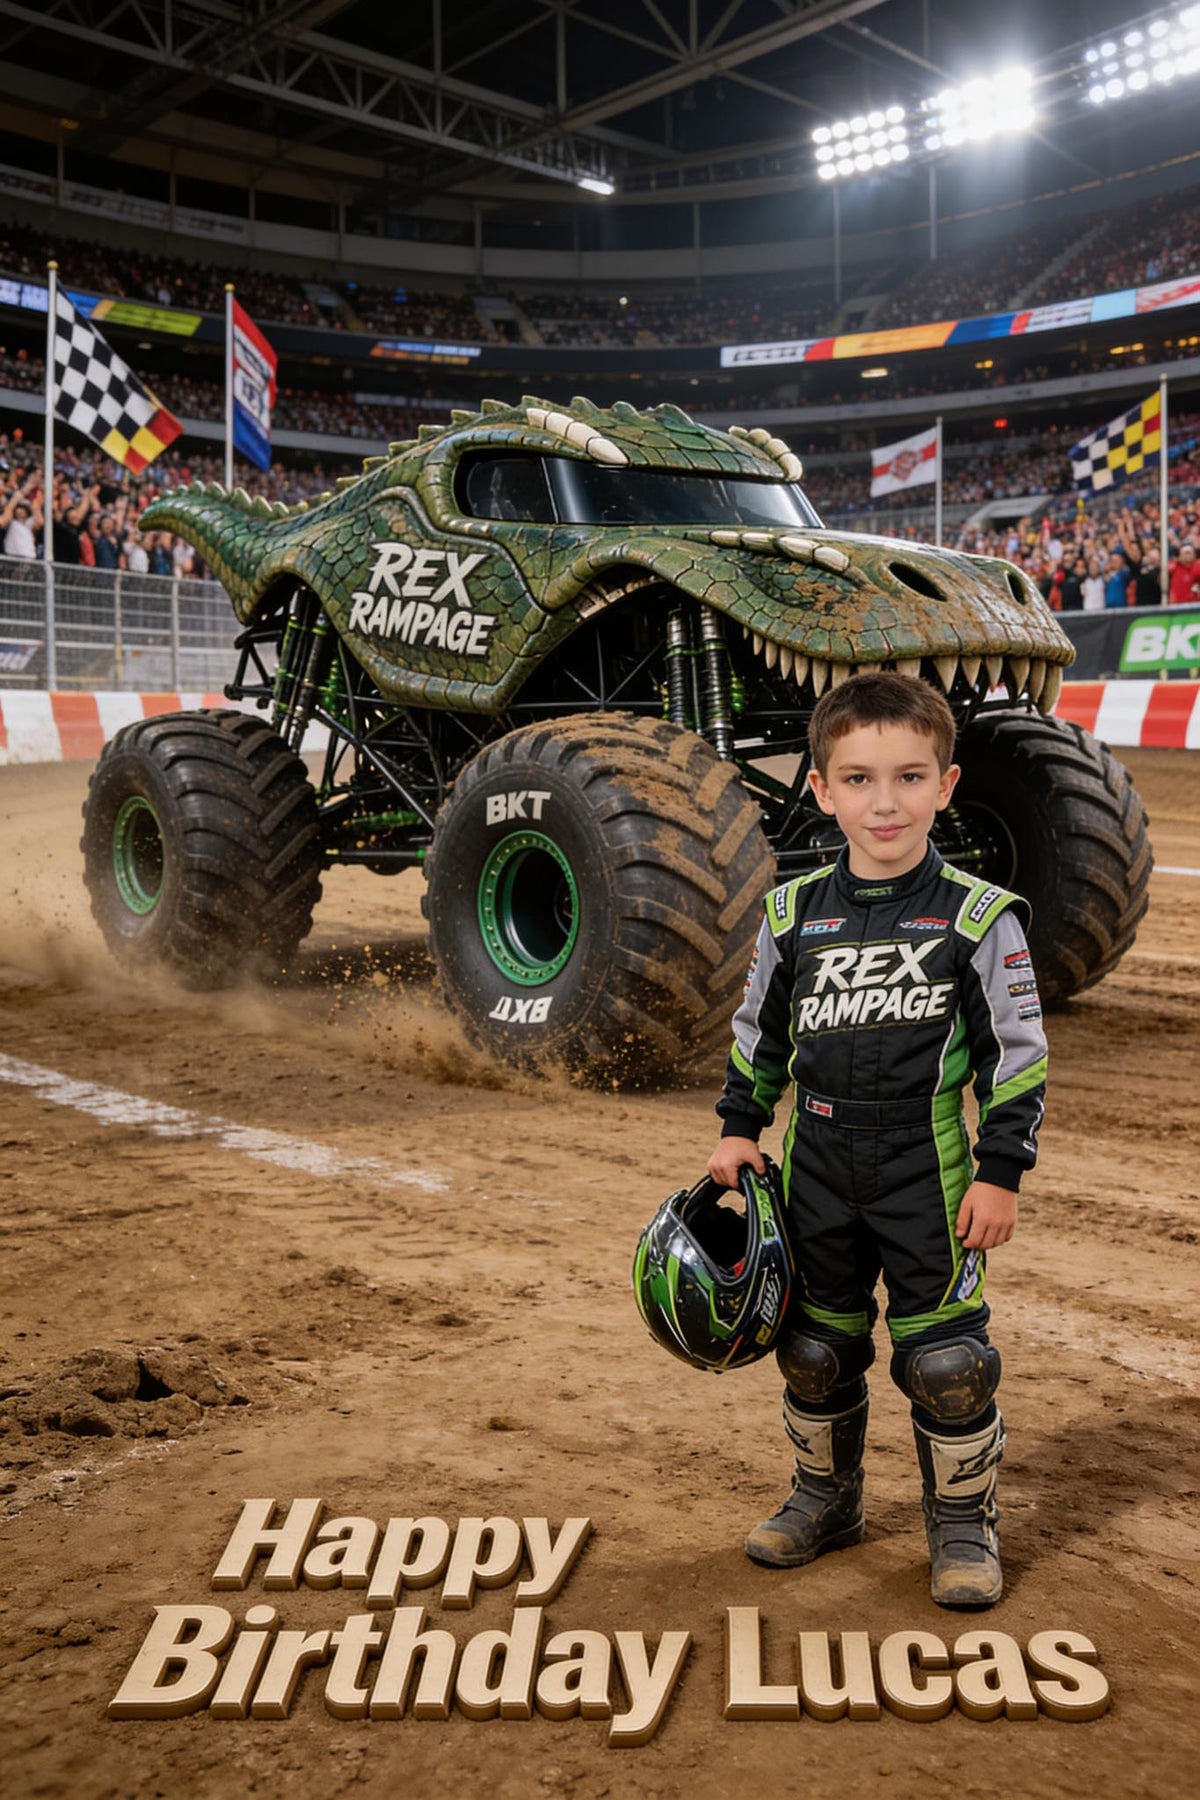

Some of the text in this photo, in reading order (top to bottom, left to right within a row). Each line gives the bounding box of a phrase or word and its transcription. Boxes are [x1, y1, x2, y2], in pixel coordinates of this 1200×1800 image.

[368, 542, 488, 608] REX
[348, 591, 497, 656] RAMPAGE
[1125, 624, 1200, 662] BK
[486, 790, 552, 826] BKT
[812, 937, 947, 994] REX
[797, 983, 954, 1033] RAMPAGE
